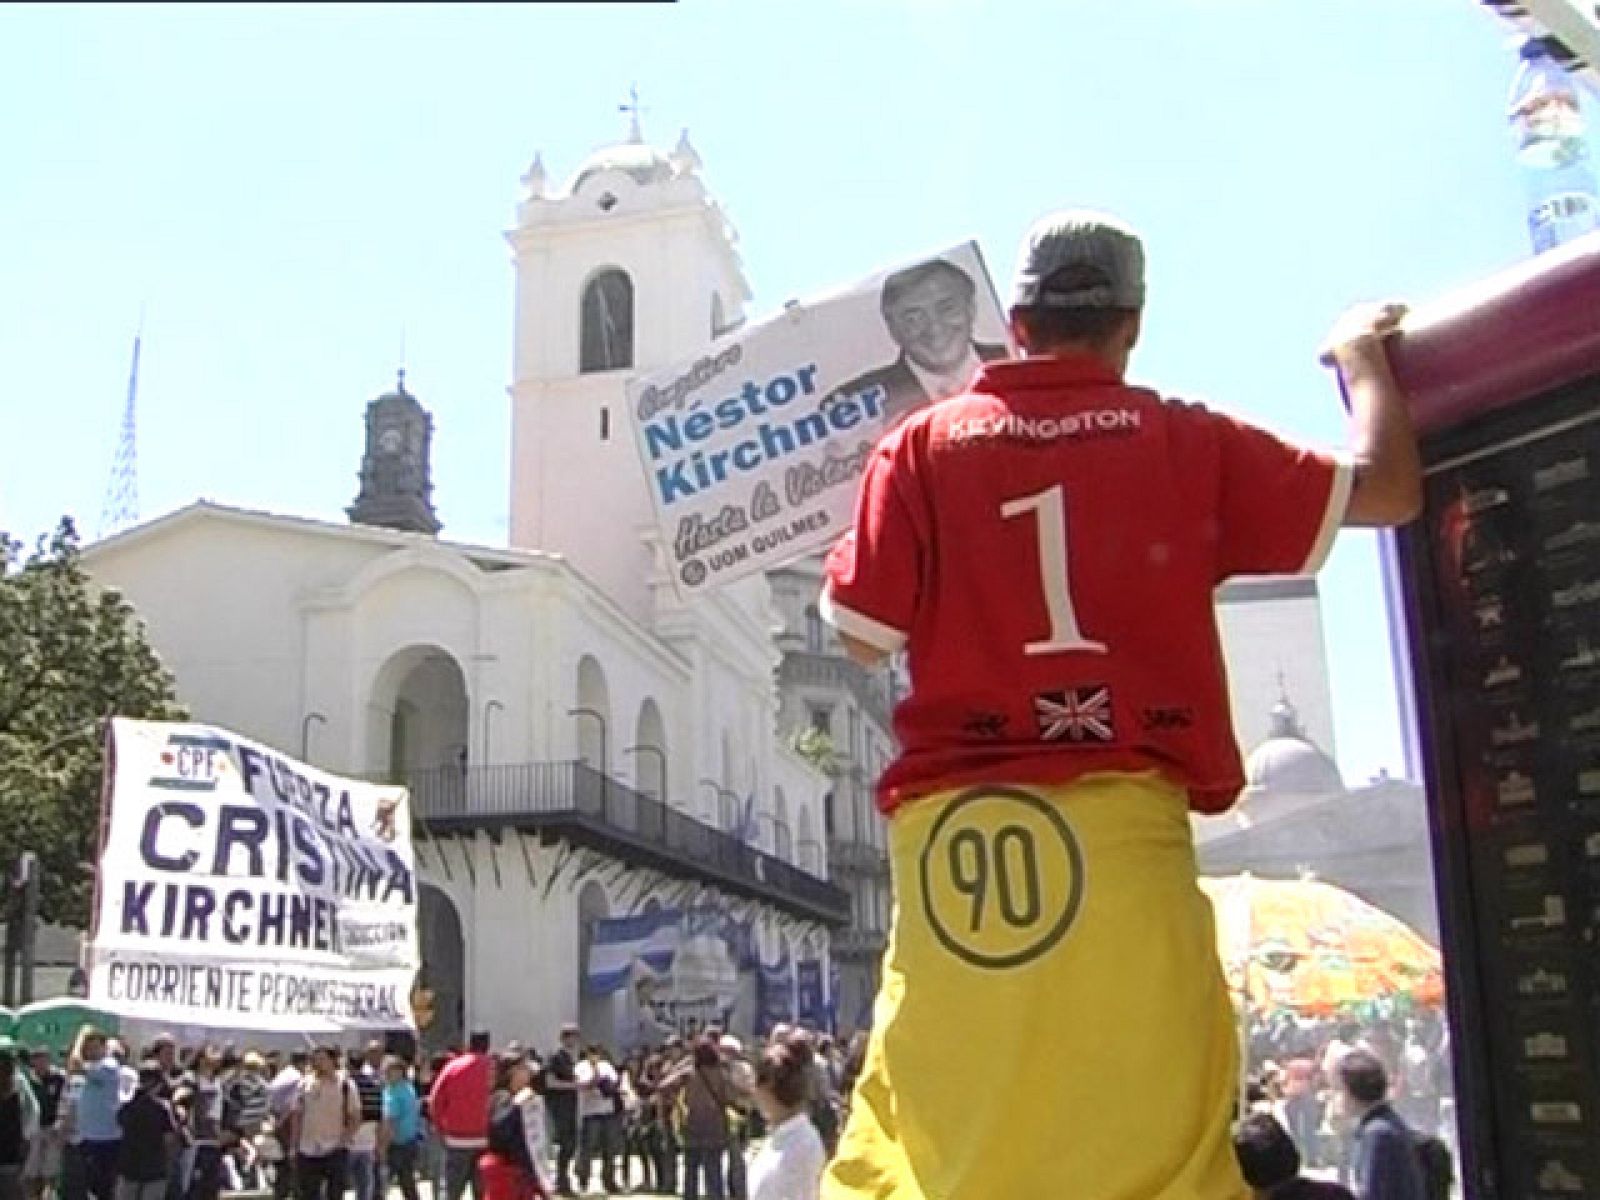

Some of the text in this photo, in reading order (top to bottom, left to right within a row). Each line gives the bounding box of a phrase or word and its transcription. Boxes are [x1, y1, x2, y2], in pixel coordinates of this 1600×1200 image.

[644, 364, 819, 461] Néstor
[656, 386, 886, 505] Kirchner
[752, 510, 831, 553] QUILMES
[1000, 483, 1110, 656] 1
[139, 801, 412, 904] CRISTINA
[949, 824, 1042, 933] 90
[108, 961, 254, 1012] CORRIENTE
